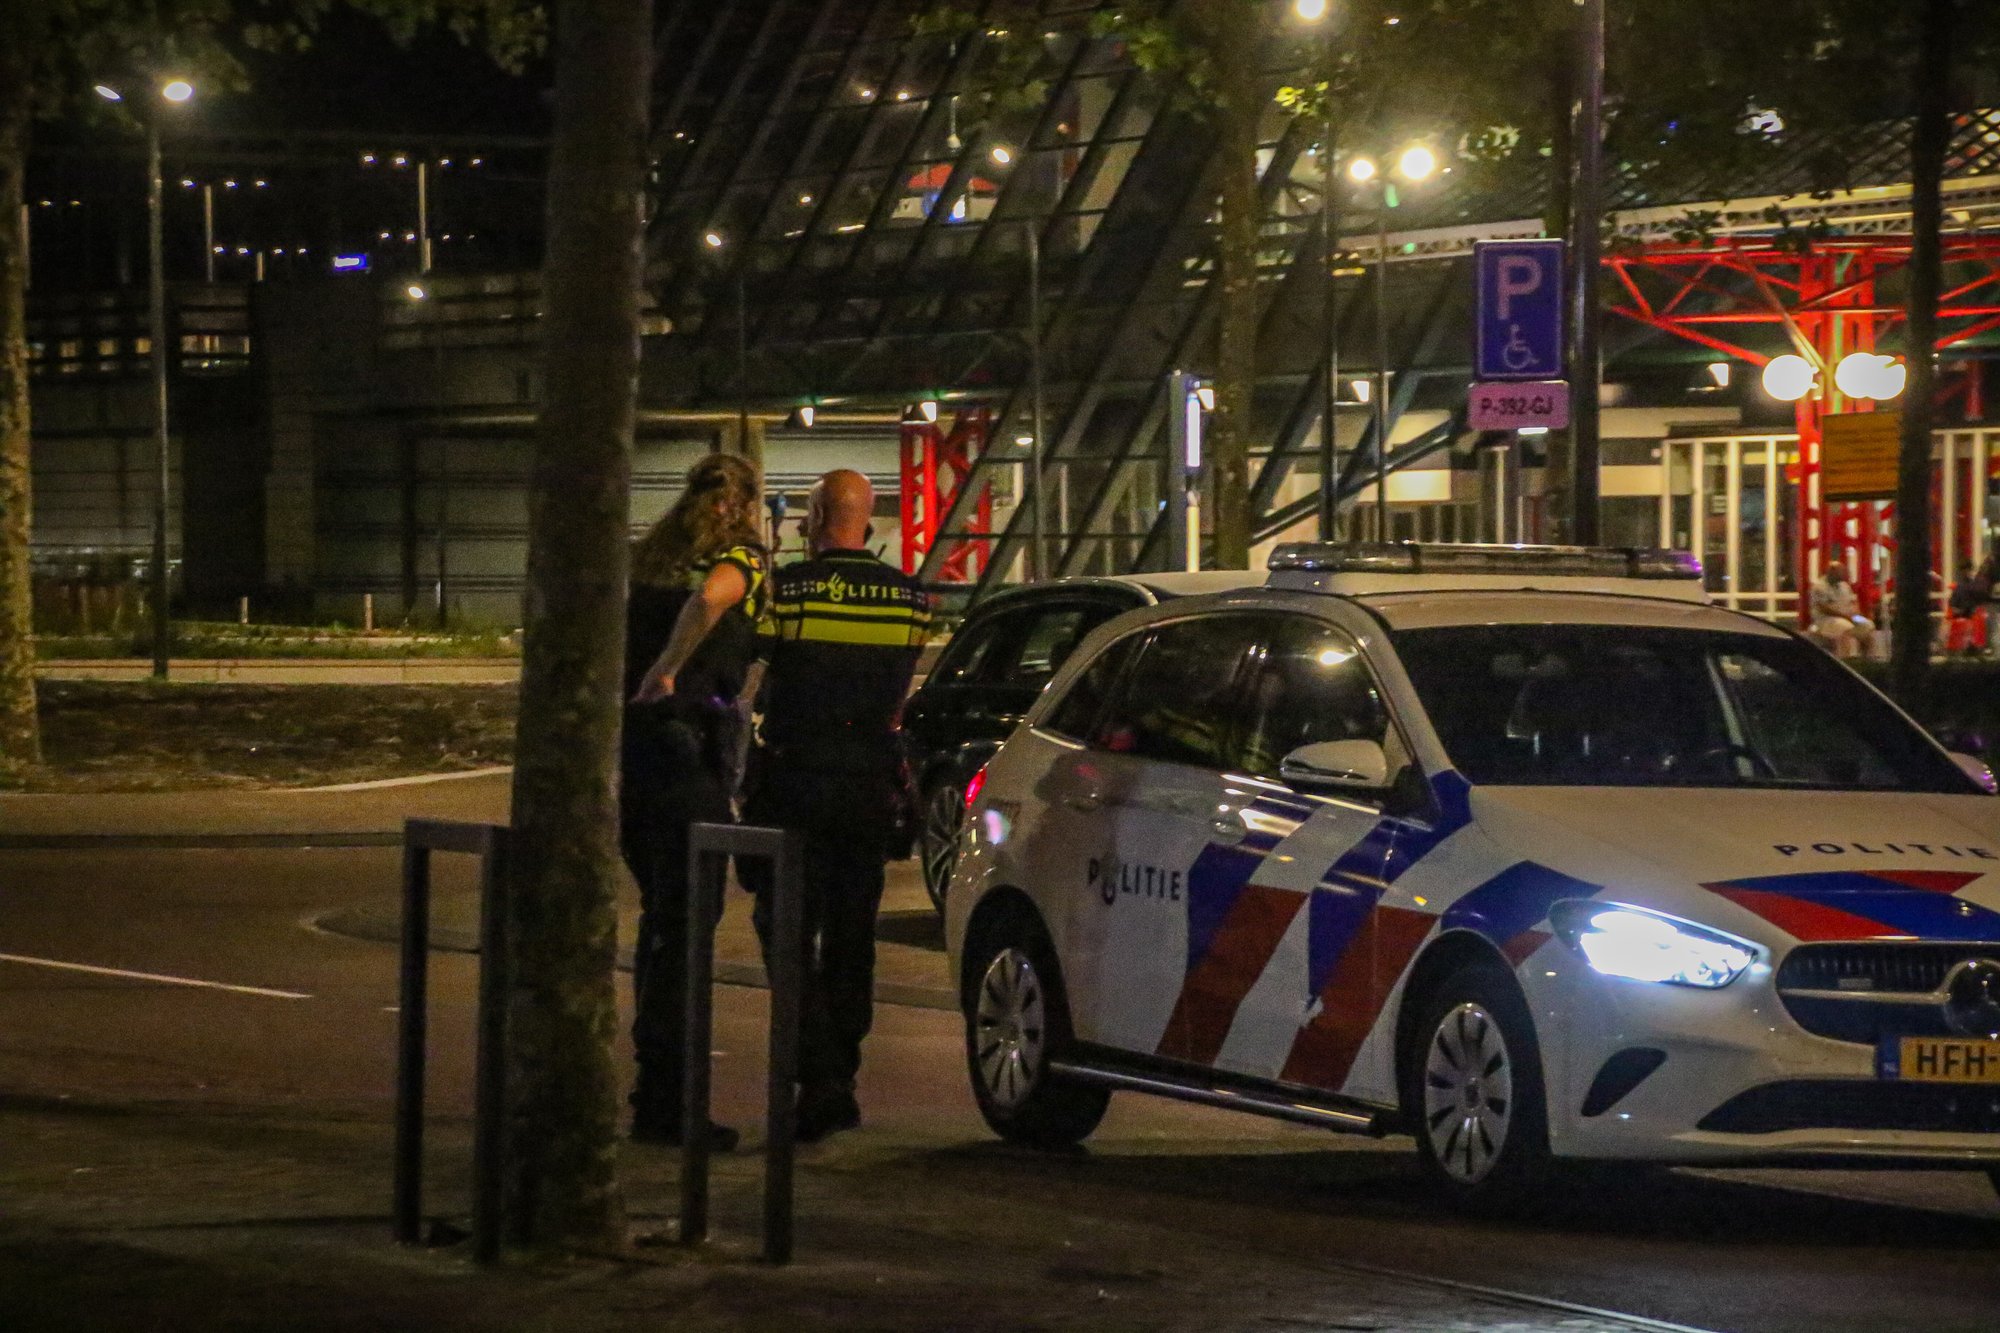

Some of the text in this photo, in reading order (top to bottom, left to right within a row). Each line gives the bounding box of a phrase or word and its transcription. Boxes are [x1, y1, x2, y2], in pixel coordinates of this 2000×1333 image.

[1498, 255, 1542, 320] P
[815, 572, 902, 602] POLITIE
[1772, 842, 1999, 861] POLITIE
[1088, 857, 1180, 906] POLITIE
